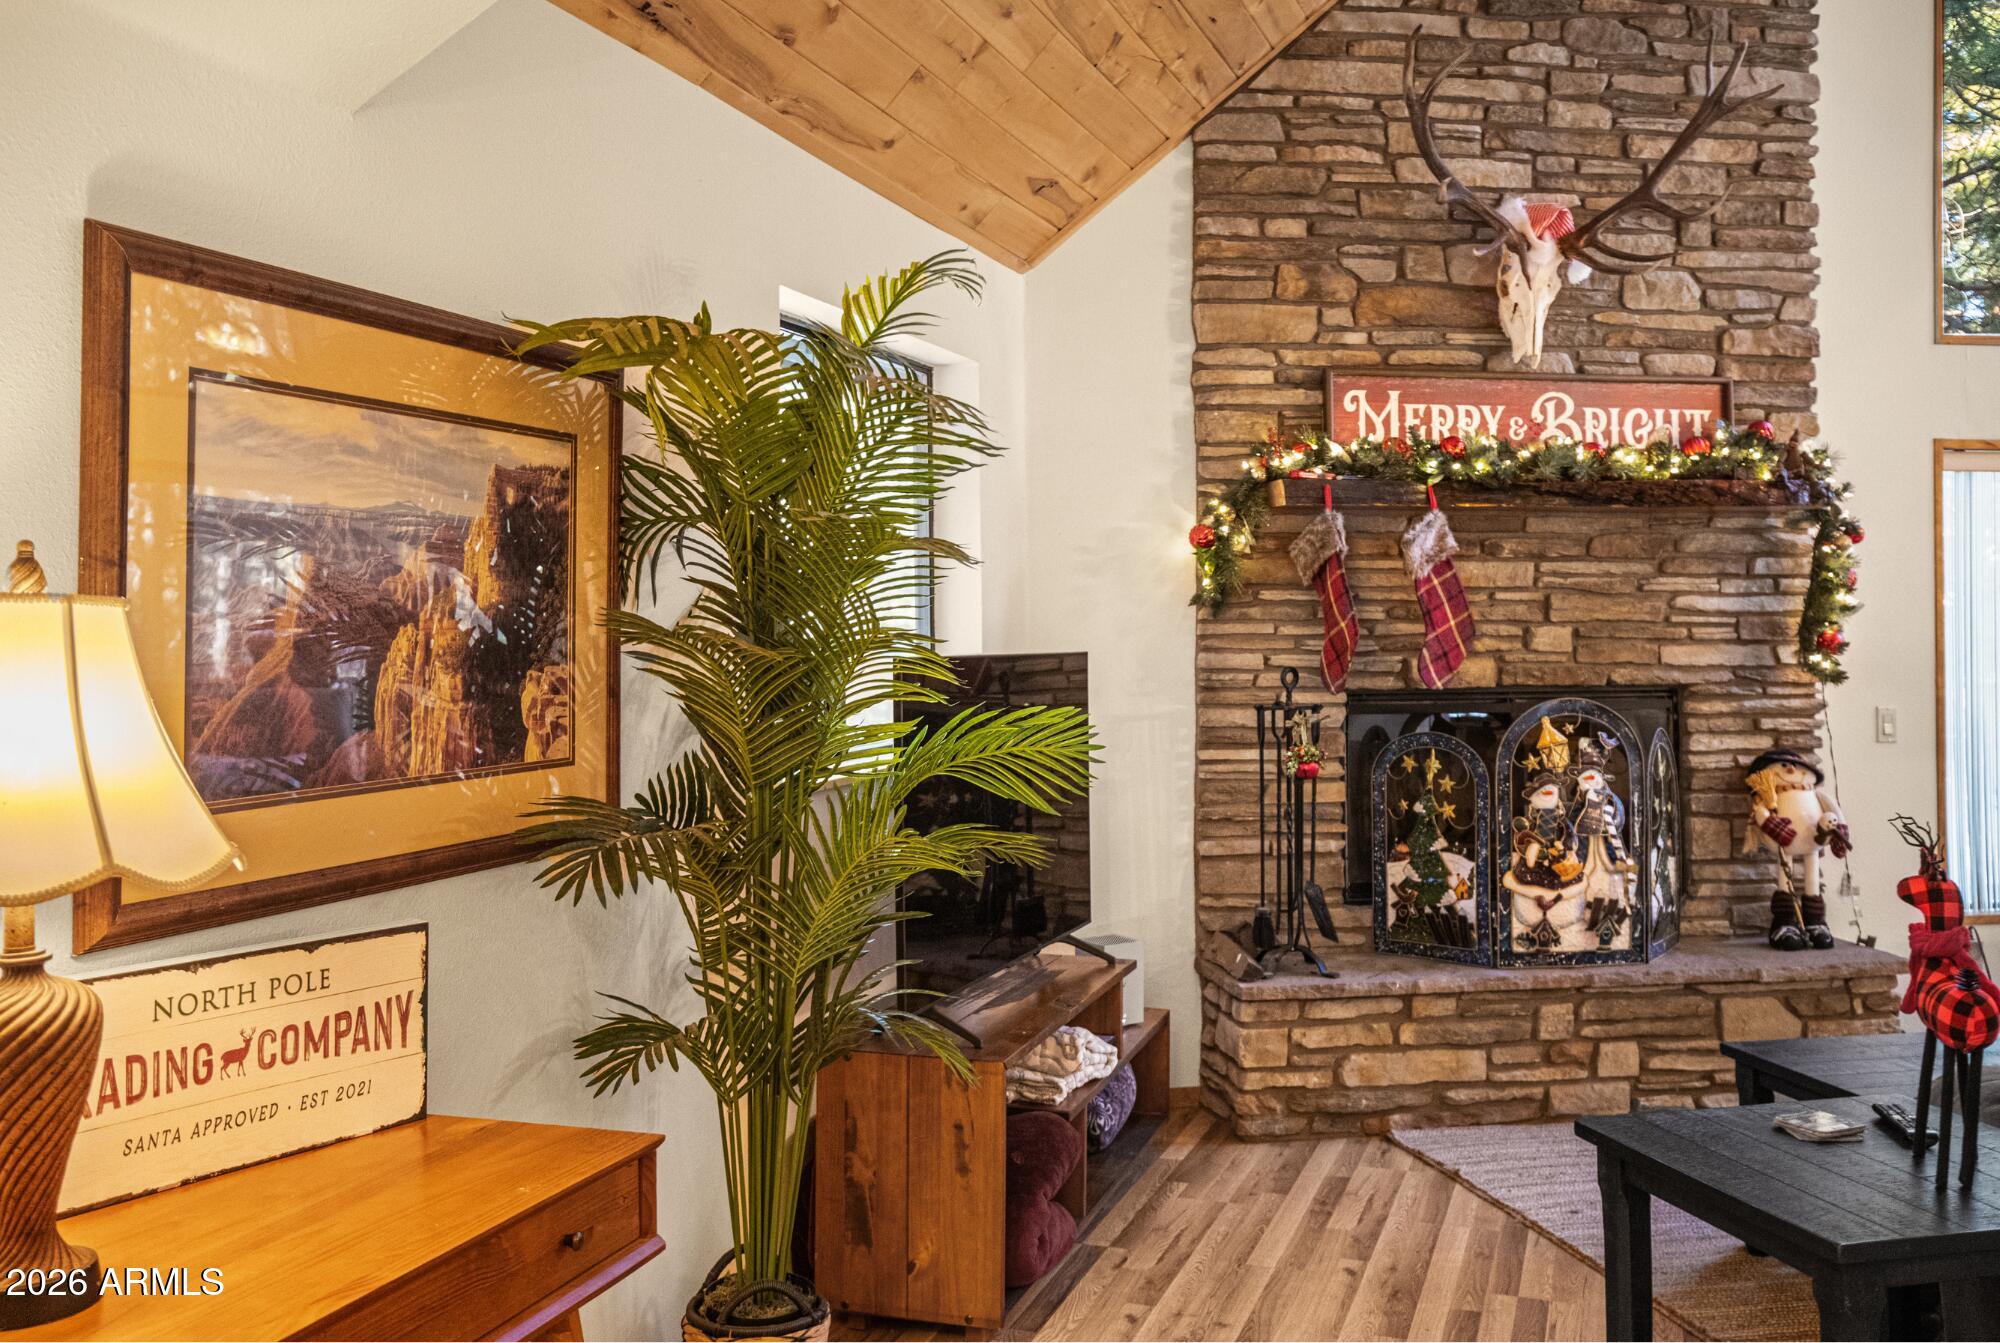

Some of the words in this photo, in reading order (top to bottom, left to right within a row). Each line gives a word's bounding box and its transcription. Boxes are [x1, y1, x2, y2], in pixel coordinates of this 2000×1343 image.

[1343, 389, 1506, 447] MERRY
[1508, 416, 1528, 442] &
[1531, 391, 1713, 450] BRIGHT
[152, 979, 257, 1023] NORTH
[269, 968, 332, 1001] POLE
[82, 1042, 214, 1120] ADING
[257, 989, 415, 1071] COMPANY
[122, 1128, 182, 1158] SANTA
[190, 1102, 279, 1140] APPROVED
[299, 1089, 330, 1112] EST
[335, 1079, 373, 1102] 2021
